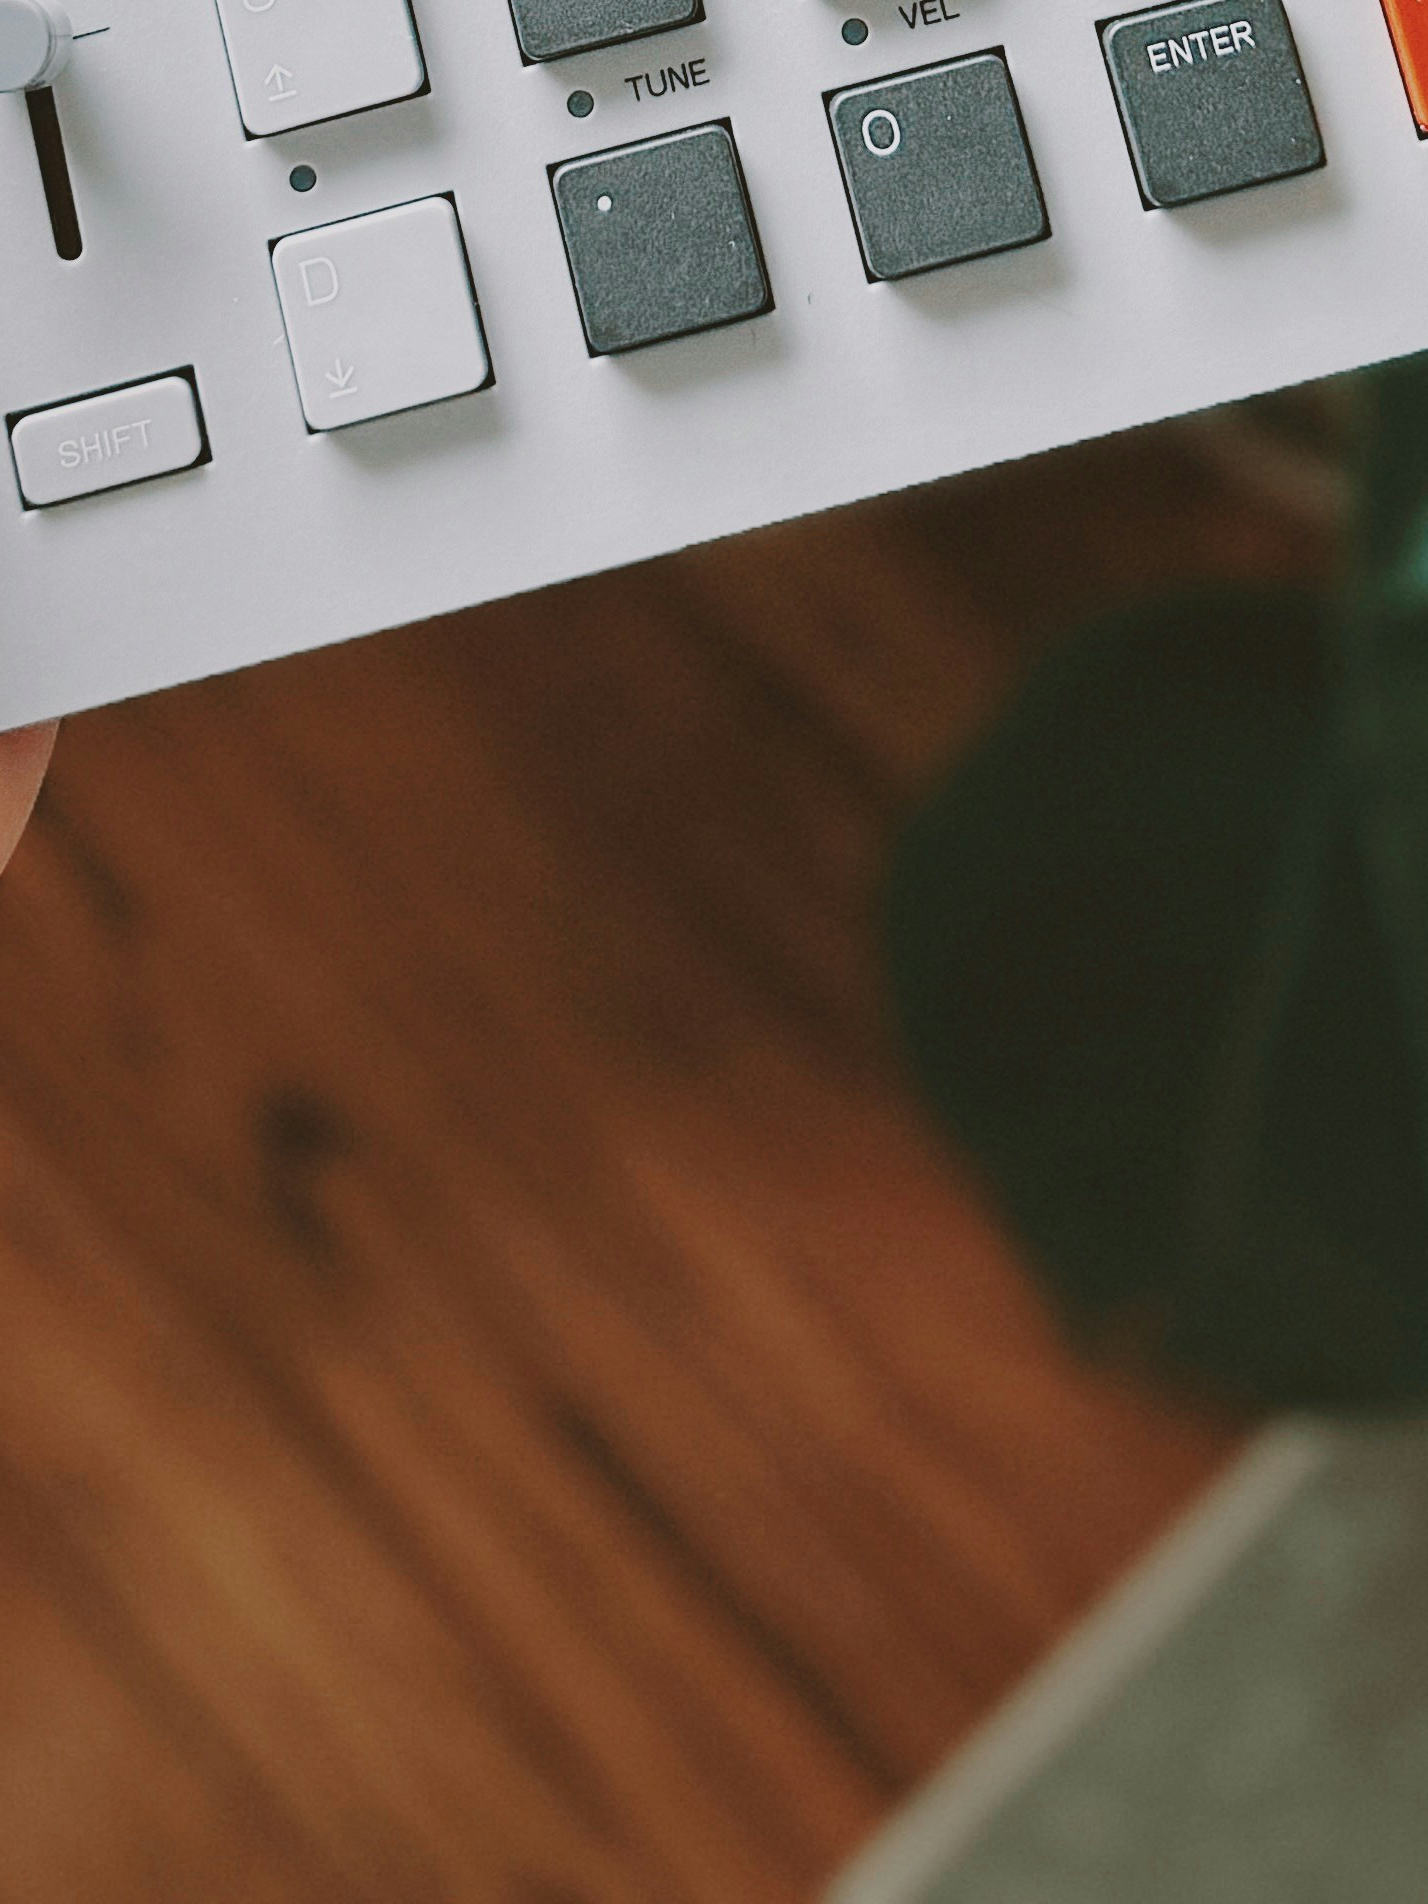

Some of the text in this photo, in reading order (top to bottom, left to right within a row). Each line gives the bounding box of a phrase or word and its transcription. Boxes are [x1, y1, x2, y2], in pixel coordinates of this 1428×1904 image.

[1146, 20, 1255, 73] ENTER
[623, 58, 711, 104] TUNE
[862, 109, 901, 156] 0
[298, 255, 340, 306] D
[57, 418, 153, 470] SHIFT
